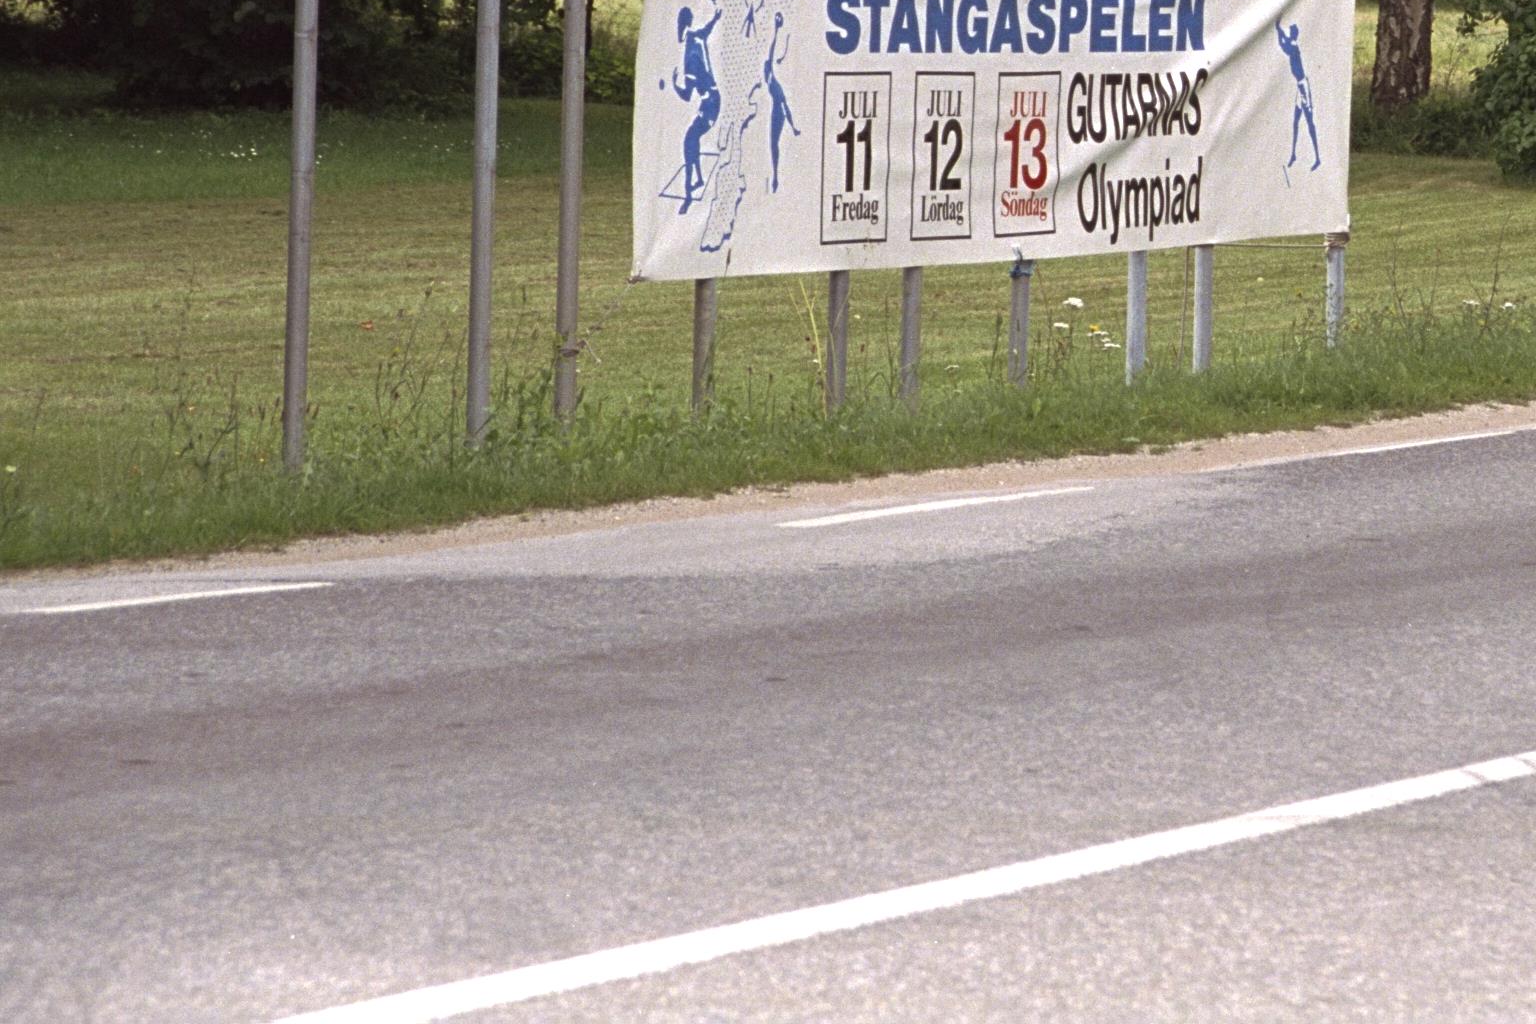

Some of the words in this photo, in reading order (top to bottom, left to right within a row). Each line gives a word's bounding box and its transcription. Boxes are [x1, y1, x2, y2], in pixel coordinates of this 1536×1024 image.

[839, 91, 878, 119] JULI
[926, 90, 962, 118] JULI
[1010, 90, 1047, 117] JULI
[1067, 68, 1208, 144] GUTARNAS
[836, 119, 874, 193] 11
[923, 118, 962, 191] 12
[1004, 118, 1048, 190] 13
[831, 194, 879, 225] Fredag
[920, 195, 964, 225] Lördag
[1000, 190, 1048, 221] Söndag
[1078, 155, 1201, 244] Olympiad
